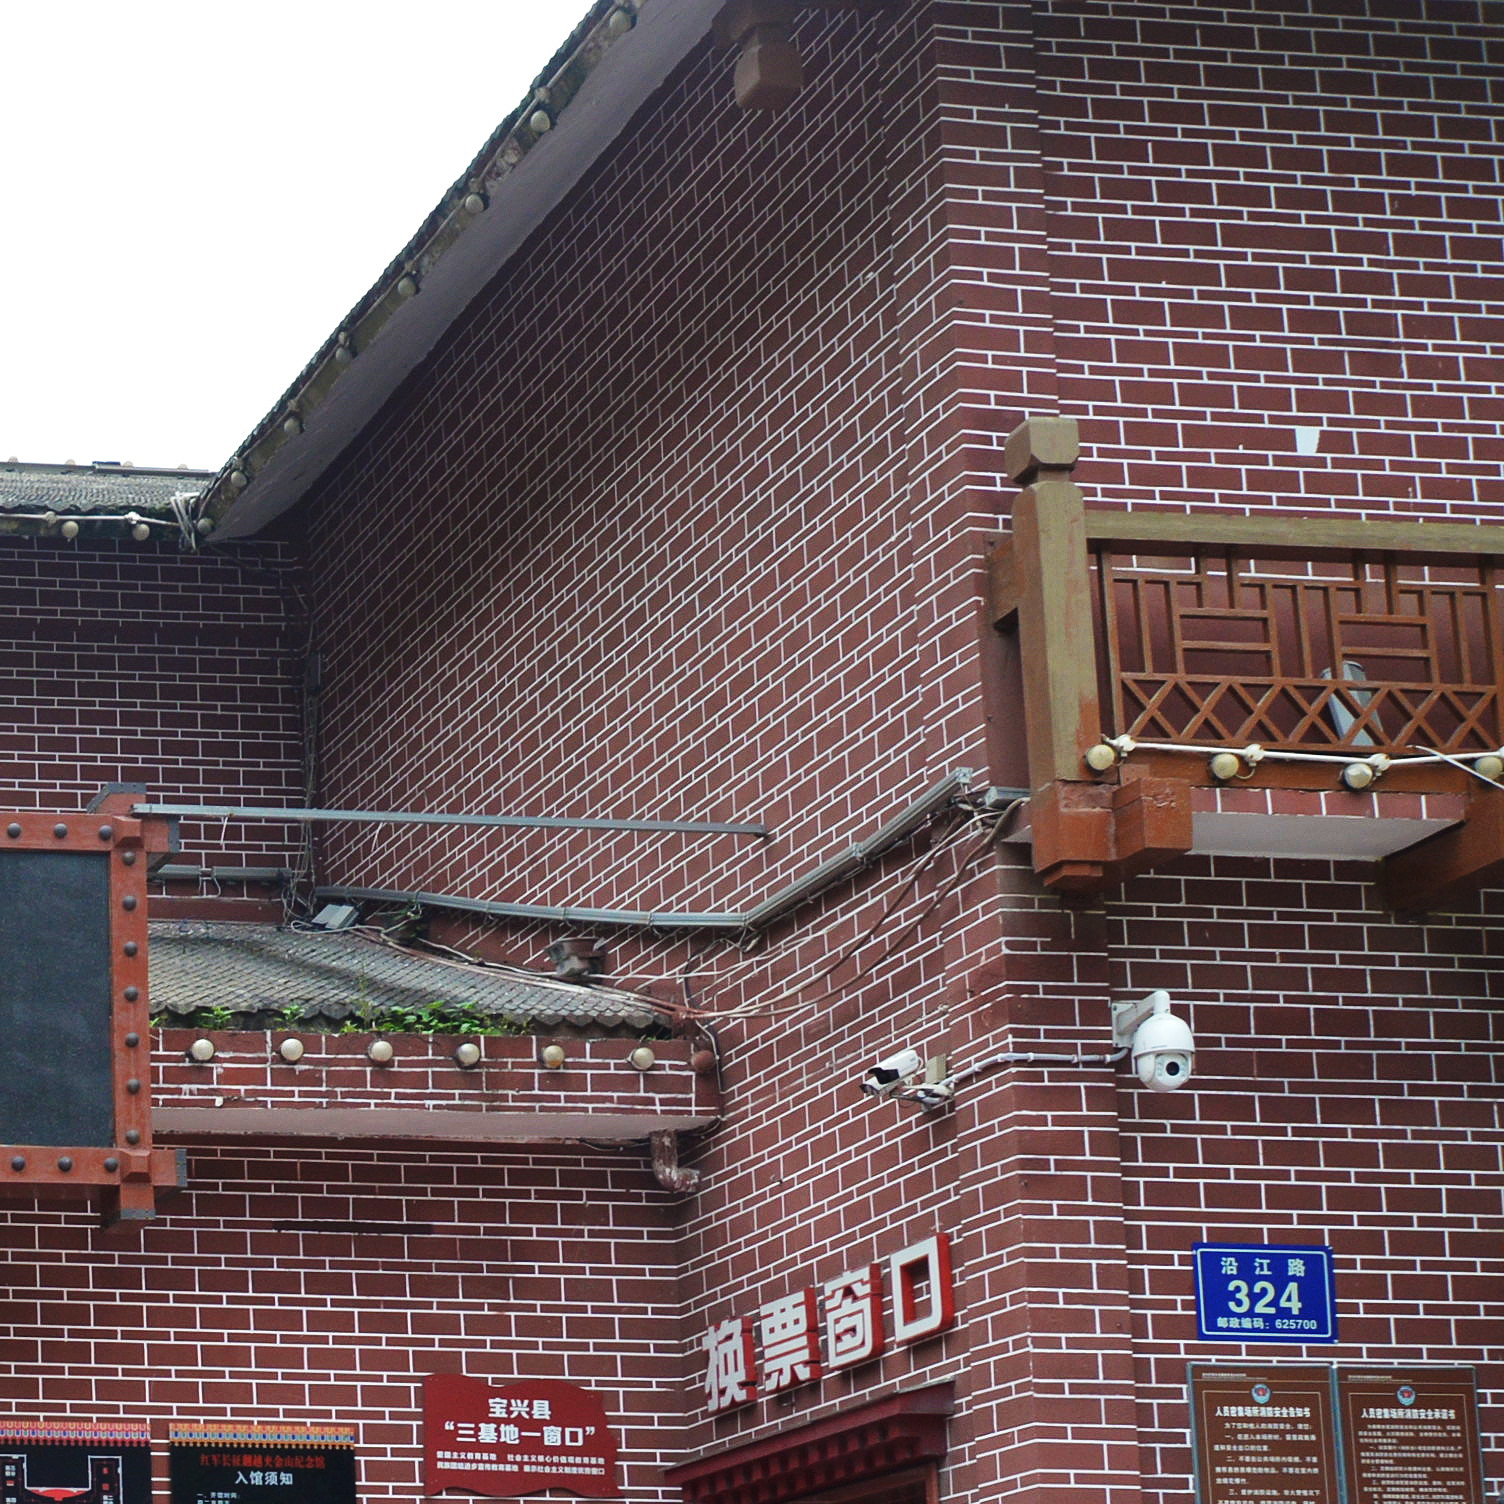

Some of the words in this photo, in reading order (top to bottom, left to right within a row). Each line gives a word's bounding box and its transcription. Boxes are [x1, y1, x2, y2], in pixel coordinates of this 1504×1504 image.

[1220, 1257, 1305, 1277] 沿江路
[1227, 1280, 1302, 1315] 324
[702, 1235, 944, 1412] 换票窗口
[488, 1398, 551, 1420] 宝兴县
[235, 1471, 293, 1486] 入馆须知
